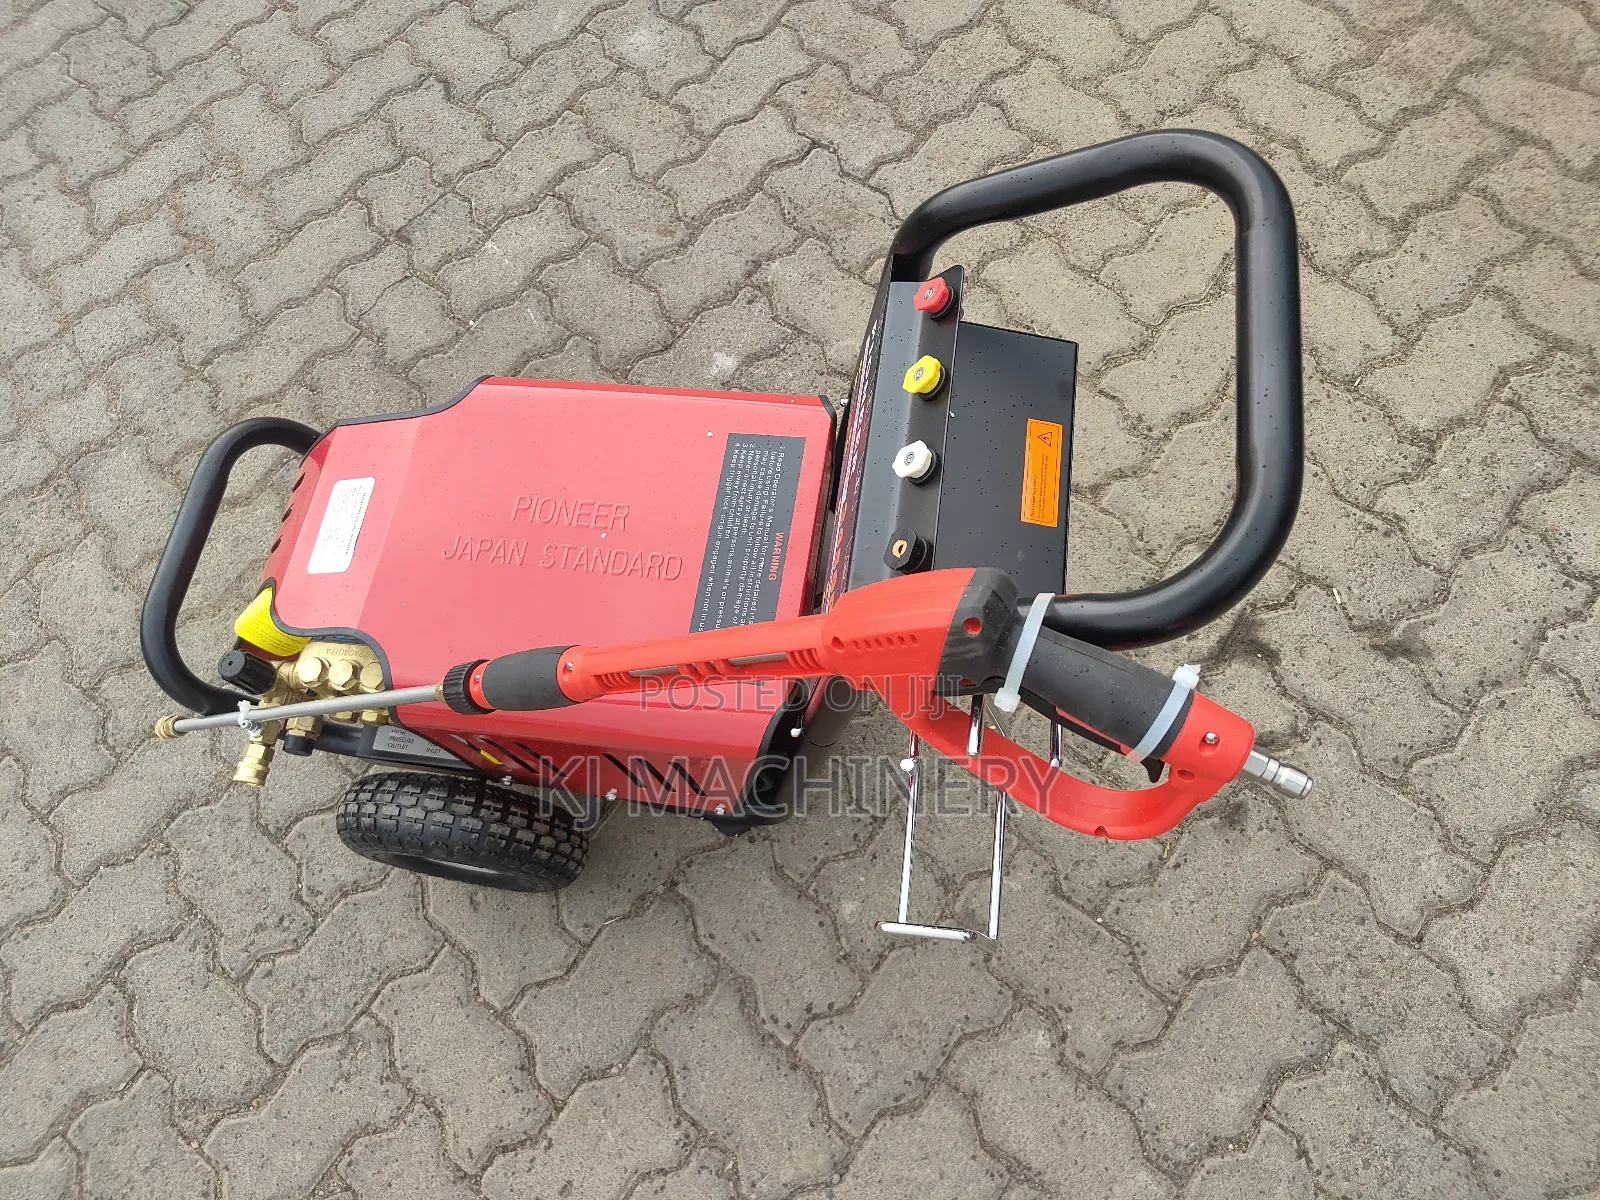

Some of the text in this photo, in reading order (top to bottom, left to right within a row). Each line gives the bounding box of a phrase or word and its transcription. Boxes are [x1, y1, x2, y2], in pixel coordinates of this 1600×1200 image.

[750, 450, 761, 482] personal
[760, 450, 769, 465] may
[767, 451, 778, 475] before
[726, 470, 735, 494] trigger
[733, 470, 741, 489] away
[740, 474, 749, 494] direct
[757, 468, 766, 489] cause
[722, 496, 730, 510] lock
[731, 490, 740, 507] from
[745, 484, 757, 504] injury
[511, 494, 629, 531] PIONEER
[735, 496, 745, 516] spray
[751, 490, 762, 520] damage
[758, 500, 769, 526] Failure
[735, 518, 741, 526] at
[740, 514, 750, 538] death.
[750, 522, 756, 530] to
[756, 527, 764, 535] to
[763, 516, 774, 544] Manual
[441, 534, 682, 580] JAPAN STANDARD
[752, 536, 762, 558] follow
[768, 532, 784, 581] WARNING
[709, 541, 721, 574] engaged
[756, 557, 765, 577] more
[705, 576, 714, 597] when
[720, 592, 727, 600] or
[741, 571, 756, 617] instructions
[750, 580, 762, 611] detailed
[702, 598, 710, 612] not
[733, 583, 746, 614] damage
[732, 616, 738, 624] or
[389, 736, 416, 744] PRESSURE
[391, 728, 407, 736] HIGH
[388, 742, 409, 750] OUTLET
